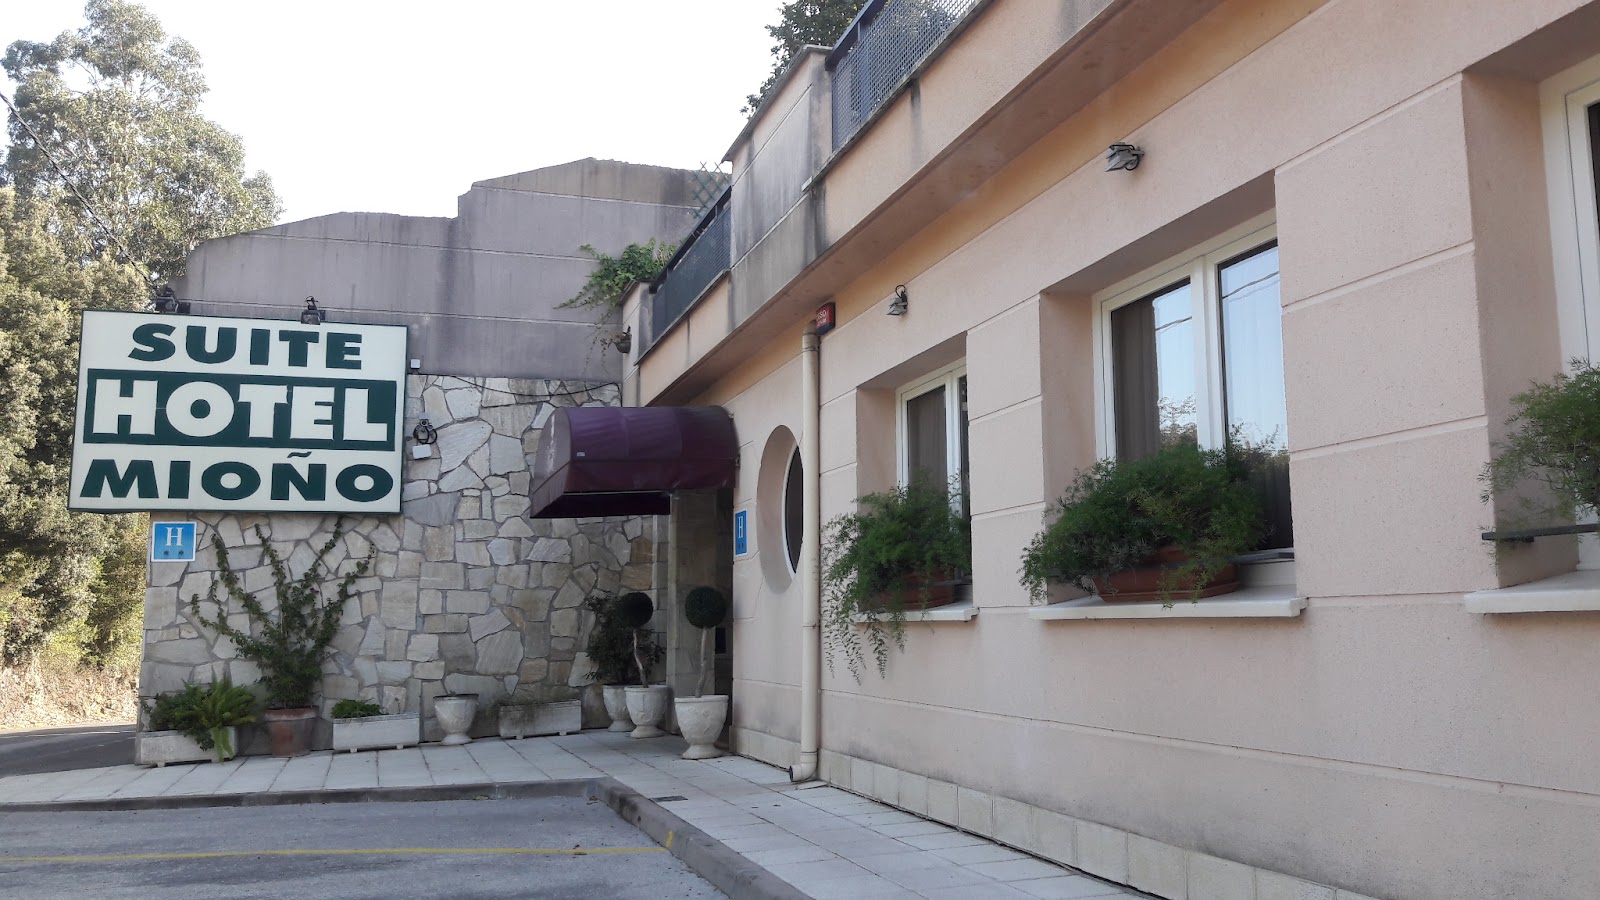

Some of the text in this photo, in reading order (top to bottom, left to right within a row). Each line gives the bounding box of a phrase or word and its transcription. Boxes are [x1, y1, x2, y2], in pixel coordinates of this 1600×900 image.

[128, 323, 363, 369] SUITE
[93, 378, 388, 442] HOTEL
[80, 451, 394, 502] MIOÑO
[165, 526, 184, 547] H
[738, 515, 744, 539] H
